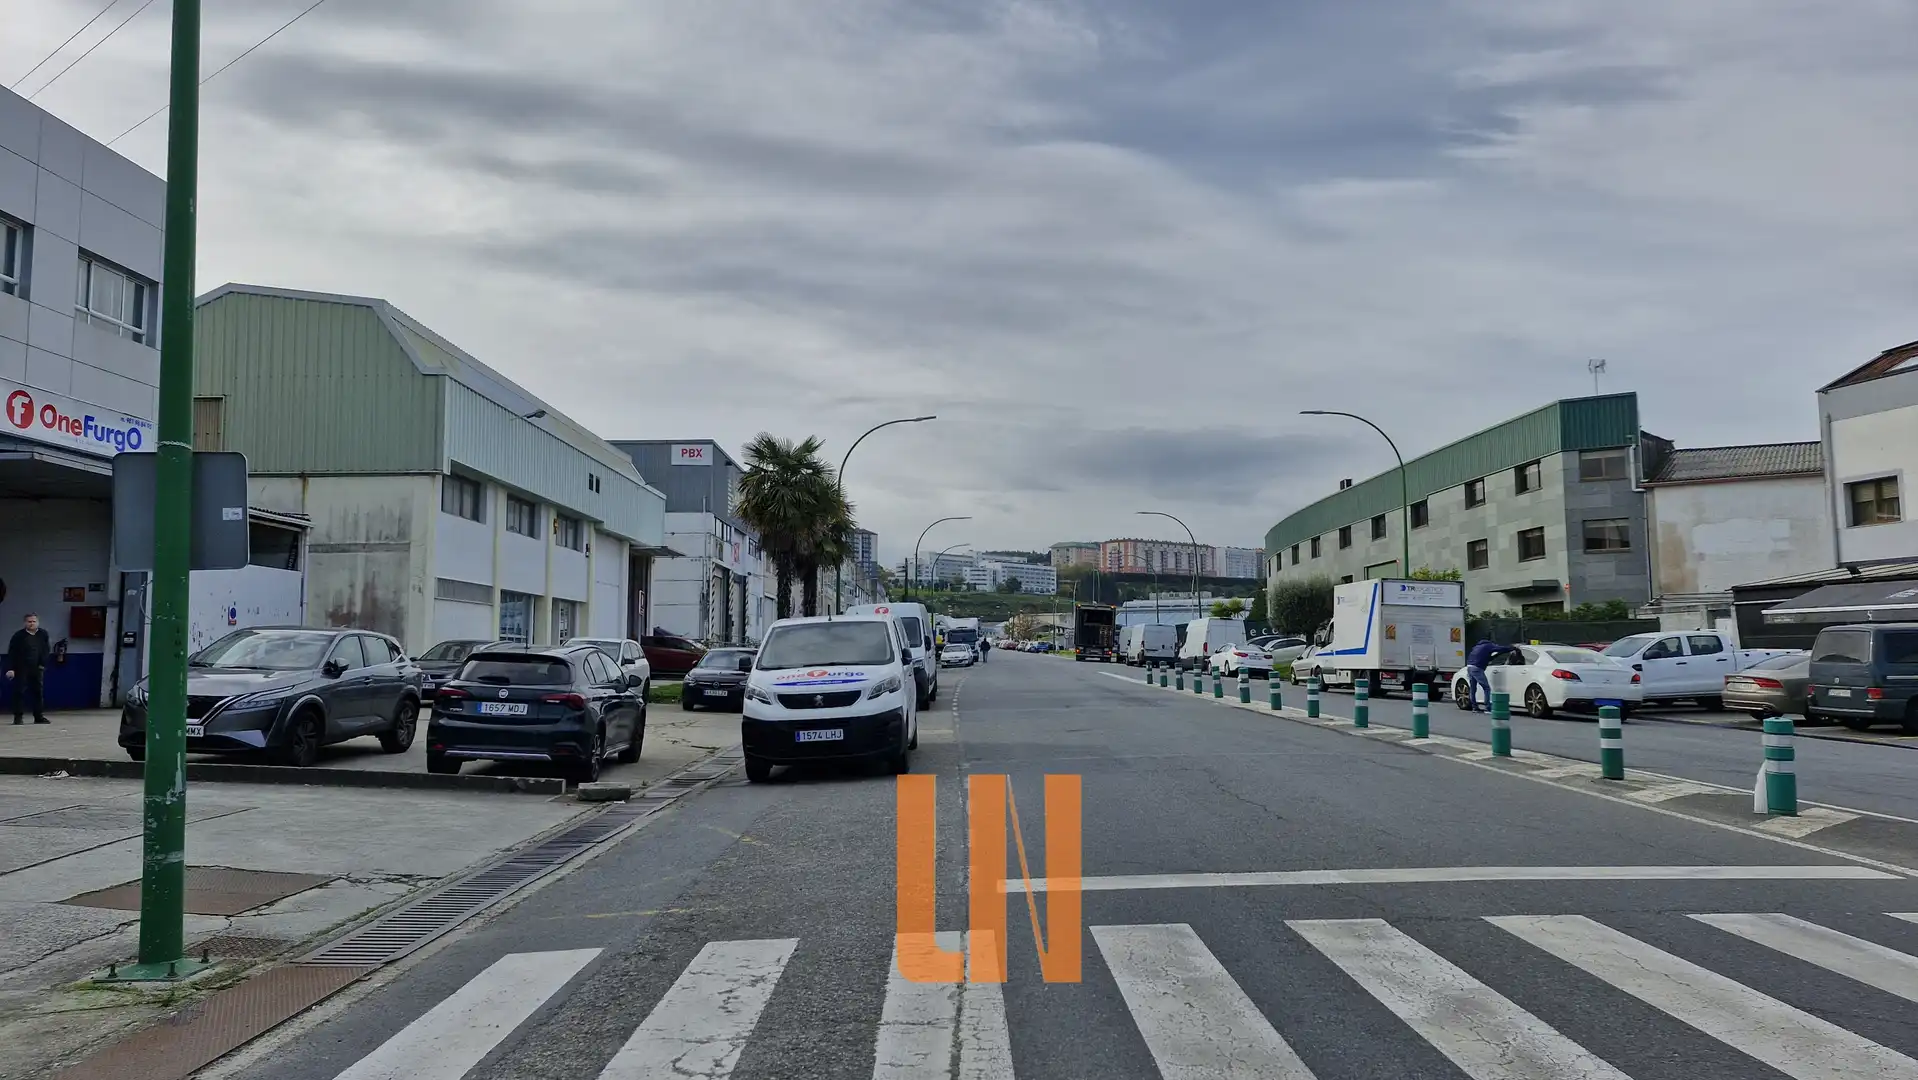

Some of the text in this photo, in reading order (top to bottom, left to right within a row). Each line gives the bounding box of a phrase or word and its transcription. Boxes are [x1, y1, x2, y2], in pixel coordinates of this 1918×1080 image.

[40, 404, 142, 453] OneFurgO
[681, 448, 703, 458] PBX
[484, 703, 526, 713] 1657 MDJ
[802, 730, 842, 740] 1574 LHJ
